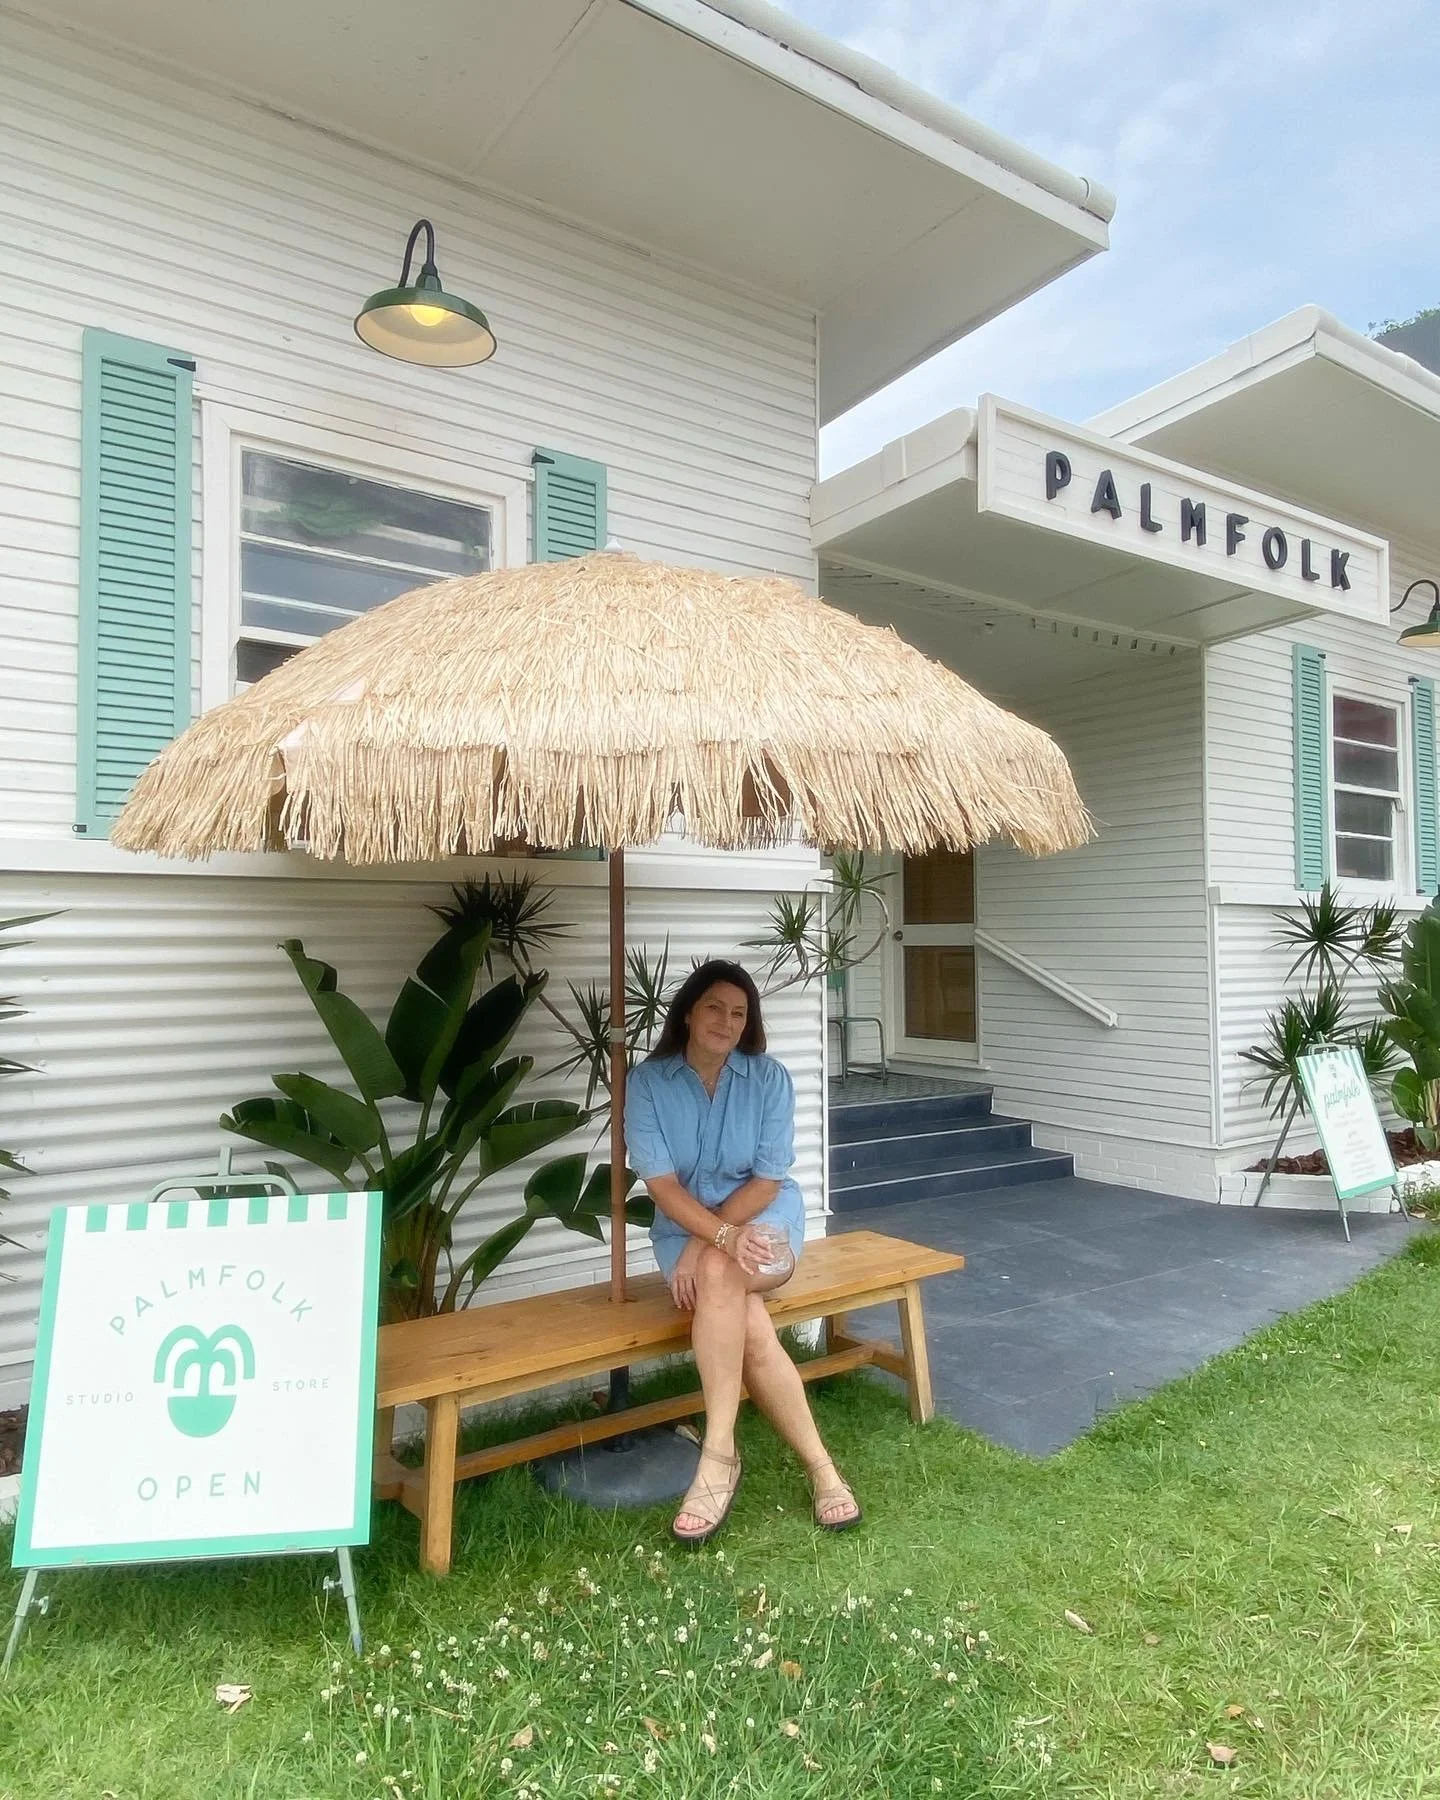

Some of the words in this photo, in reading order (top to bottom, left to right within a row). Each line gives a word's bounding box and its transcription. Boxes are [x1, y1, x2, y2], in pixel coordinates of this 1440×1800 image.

[1045, 450, 1352, 591] PALMFOLK
[1323, 1077, 1361, 1119] palmfolk
[109, 1264, 313, 1336] PALMFOLK
[65, 1391, 135, 1406] STUDIO
[272, 1377, 330, 1392] STORE
[137, 1471, 261, 1502] OPEN
